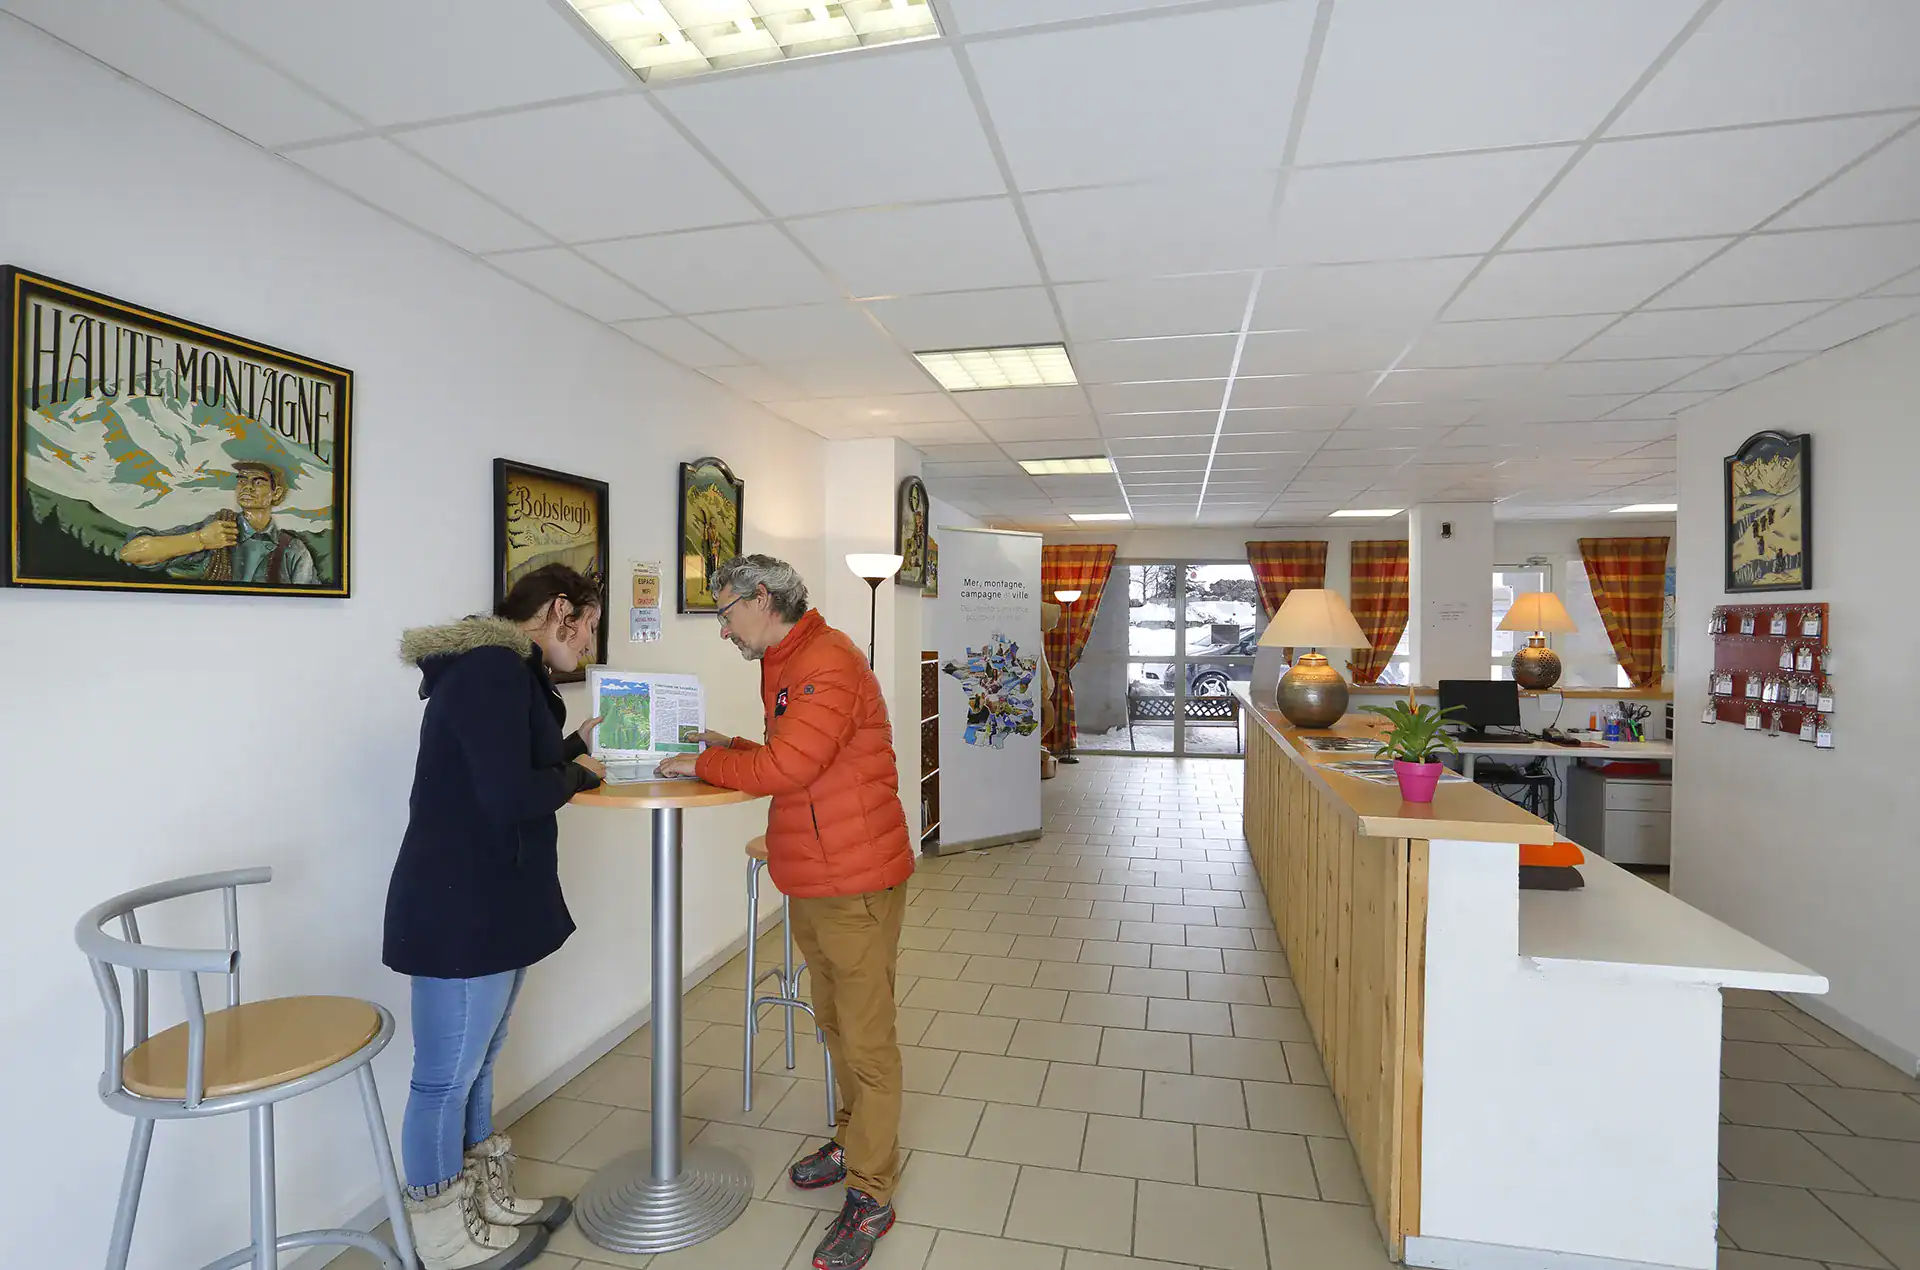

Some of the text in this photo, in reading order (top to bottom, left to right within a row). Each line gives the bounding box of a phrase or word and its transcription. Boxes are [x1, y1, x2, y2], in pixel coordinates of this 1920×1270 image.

[31, 303, 333, 465] HAUTE MONTAGNE
[513, 485, 591, 536] Bobsleigh
[960, 590, 1002, 600] campagne
[1012, 591, 1029, 600] ville
[963, 578, 1026, 590] Mer, montagne,
